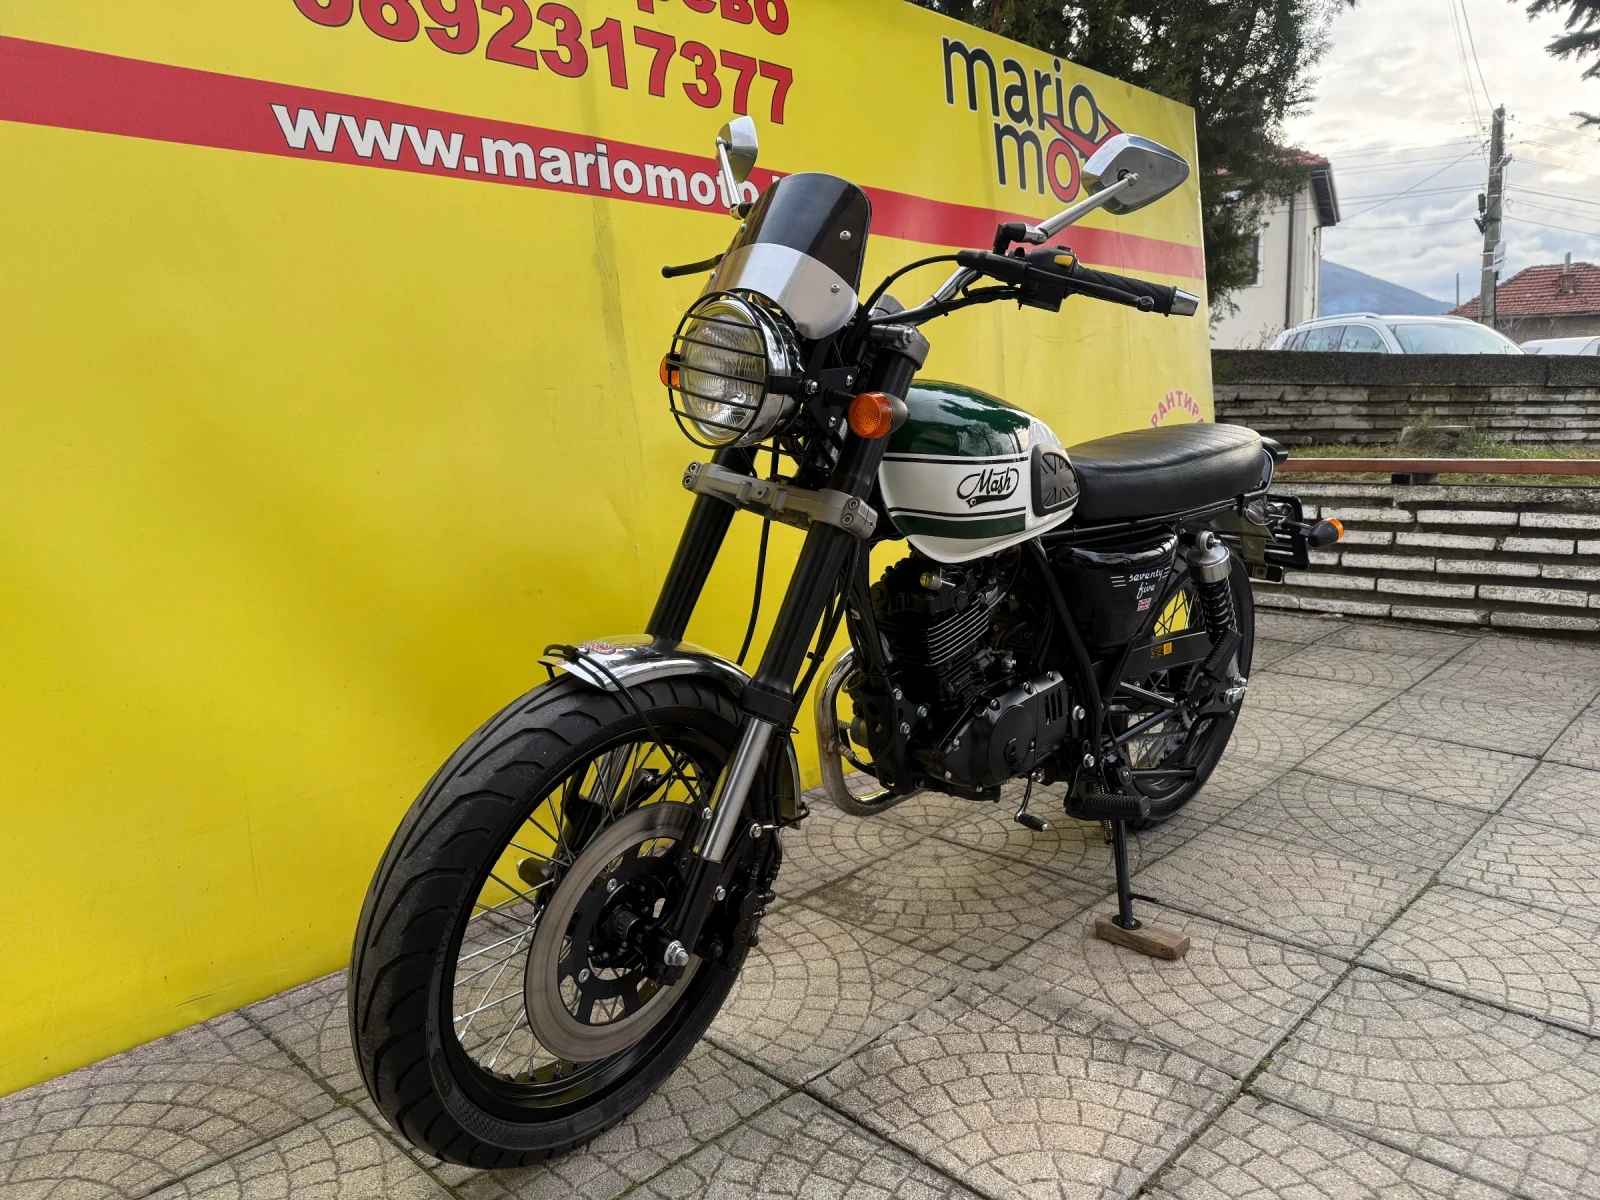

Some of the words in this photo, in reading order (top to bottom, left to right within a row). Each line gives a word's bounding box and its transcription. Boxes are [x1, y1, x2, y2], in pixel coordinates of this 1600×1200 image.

[942, 36, 1099, 142] mario
[270, 103, 781, 209] www.mariomoto
[993, 121, 1086, 204] mo
[957, 467, 1014, 499] Mash
[1128, 568, 1163, 582] seventy
[1136, 582, 1156, 599] five
